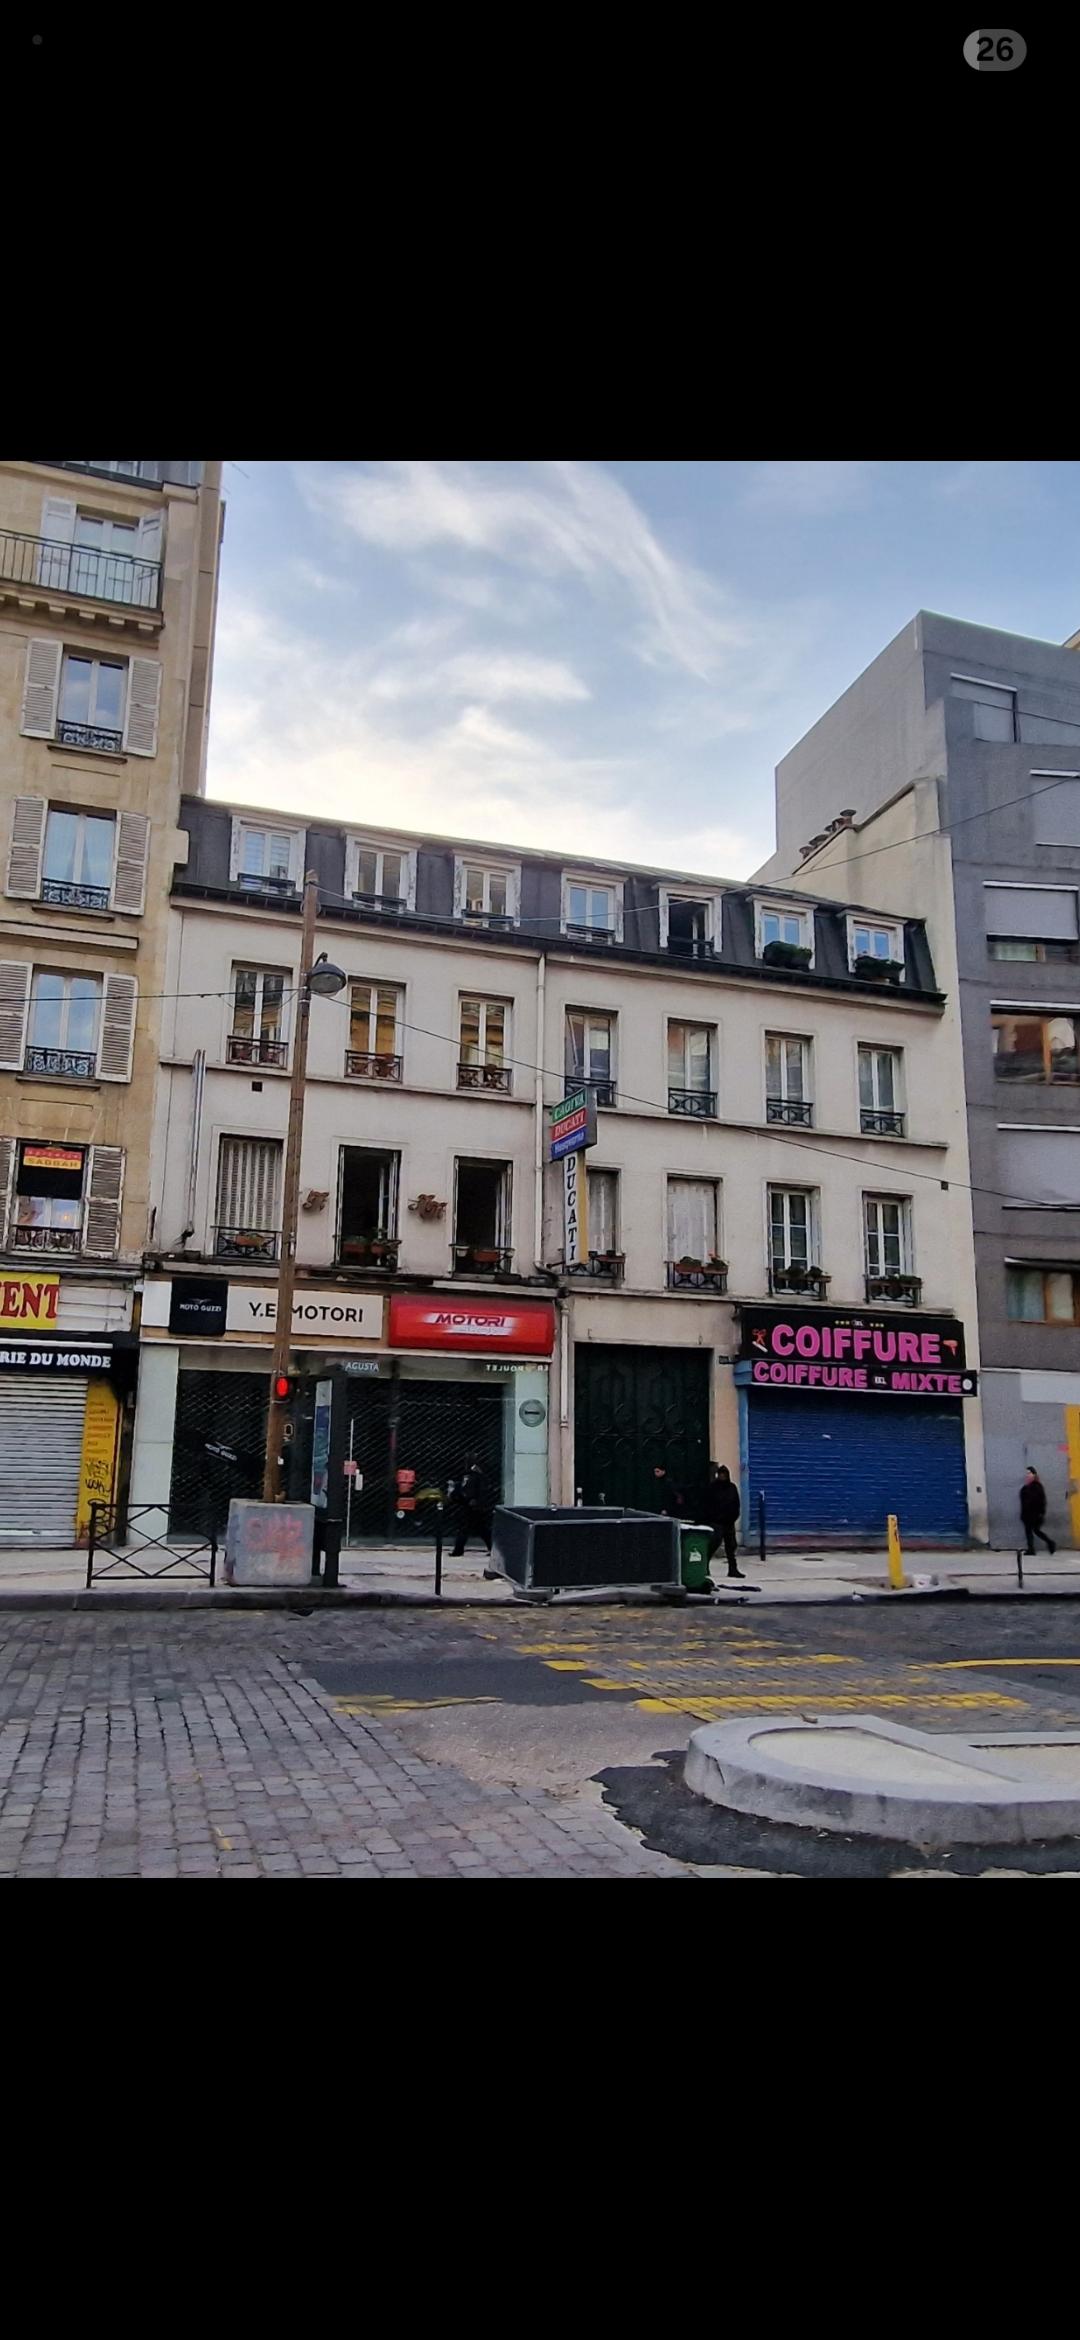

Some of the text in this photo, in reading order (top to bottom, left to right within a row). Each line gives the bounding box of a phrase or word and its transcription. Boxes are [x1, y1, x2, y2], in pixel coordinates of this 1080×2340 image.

[554, 1110, 585, 1138] DUCATI
[567, 1156, 577, 1261] DUCATI
[0, 1281, 60, 1319] ENT
[179, 1303, 222, 1312] MOTO GUZZI
[435, 1313, 506, 1327] MOTORI
[771, 1323, 942, 1364] COIFFURE
[29, 1352, 53, 1366] DU
[56, 1354, 111, 1369] MONDE
[345, 1361, 379, 1372] AGUSTA
[753, 1361, 962, 1393] COIFFURE MIXTE
